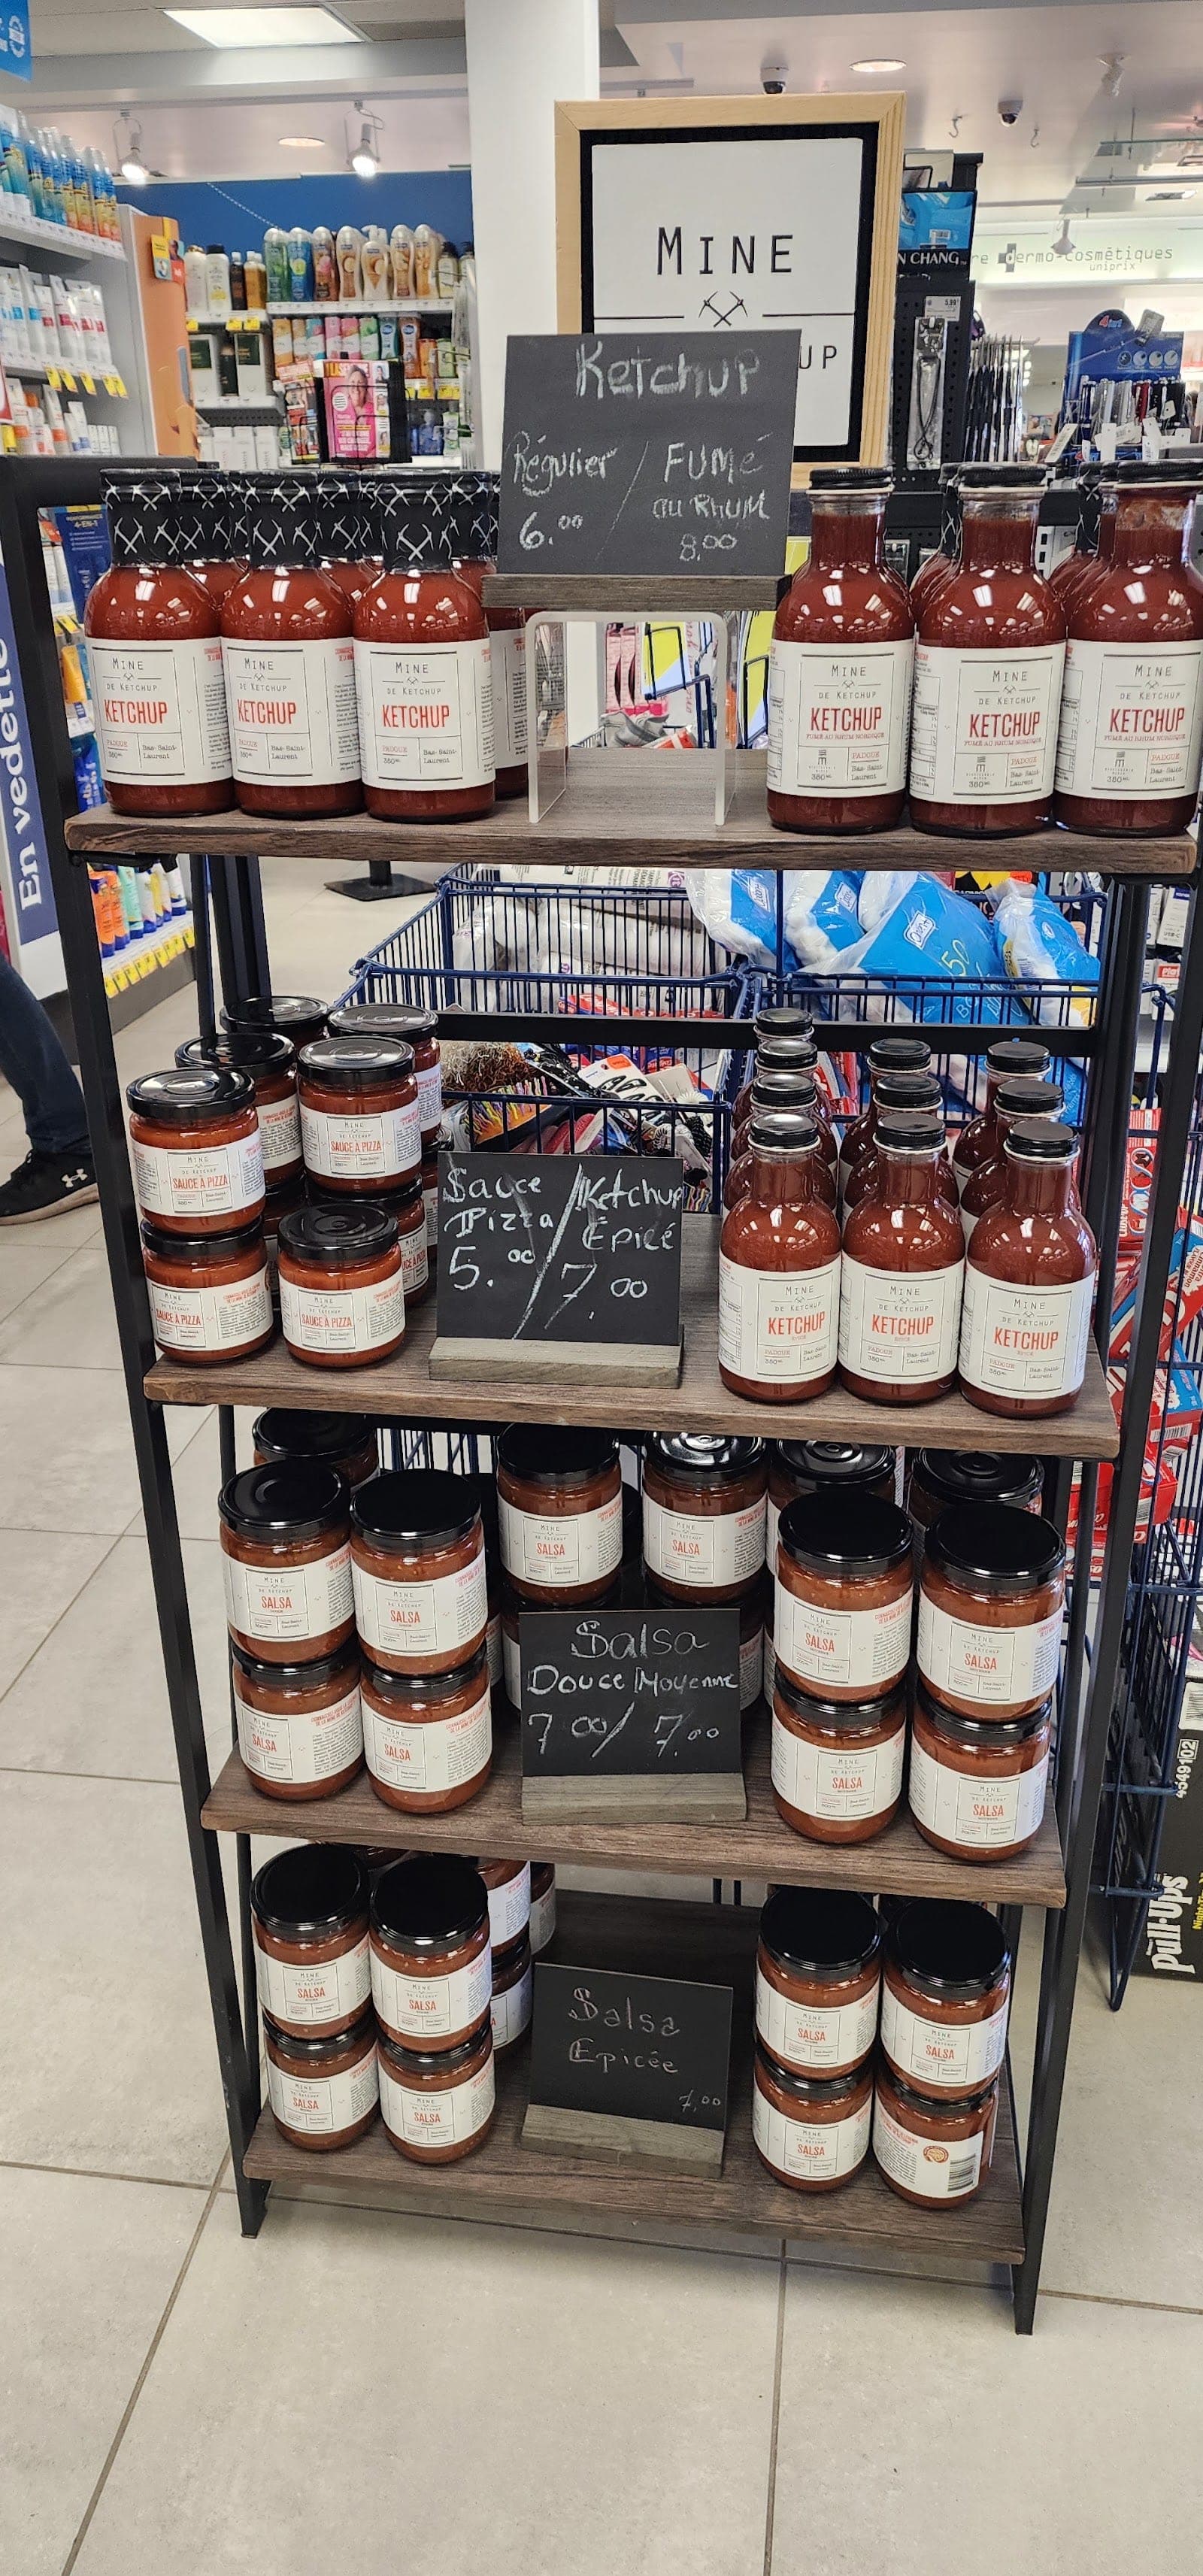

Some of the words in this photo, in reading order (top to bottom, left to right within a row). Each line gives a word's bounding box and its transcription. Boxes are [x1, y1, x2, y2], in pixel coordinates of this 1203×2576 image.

[656, 226, 794, 275] MINE
[911, 251, 960, 265] CHANG
[1089, 260, 1136, 271] uniprix
[113, 657, 144, 670] MINE
[244, 657, 274, 671] MINE
[395, 662, 429, 674] MINE
[831, 664, 867, 677] MINE
[1135, 664, 1172, 677] MINE
[992, 670, 1029, 683] MINE
[106, 683, 115, 691] DE
[120, 683, 158, 692] KETCHUP
[239, 683, 247, 691] DE
[250, 683, 287, 692] KETCHUP
[387, 687, 397, 696] DE
[402, 687, 441, 696] KETCHUP
[997, 696, 1037, 705] KETCHUP
[1120, 692, 1132, 700] DE
[1138, 691, 1180, 699] KETCHUP
[104, 699, 168, 724] KETCHUP
[237, 699, 296, 725] KETCHUP
[382, 704, 450, 729] KETCHUP
[810, 706, 882, 732] KETCHUP
[969, 711, 1041, 738] KETCHUP
[1109, 706, 1185, 733] KETCHUP
[851, 773, 877, 781] Laurent
[19, 841, 42, 911] En
[330, 1141, 353, 1153] SAUCE
[362, 1141, 382, 1151] PIZZA
[172, 1177, 198, 1190] SAUCE
[208, 1174, 229, 1187] PIZZA
[785, 1285, 814, 1296] MINE
[889, 1286, 921, 1297] MINE
[789, 1302, 822, 1311] KETCHUP
[1014, 1298, 1047, 1310] MINE
[155, 1309, 174, 1324] SAUCE
[181, 1313, 202, 1326] PIZZA
[301, 1314, 323, 1328] SAUCE
[331, 1316, 353, 1328] PIZZA
[768, 1311, 826, 1336] KETCHUP
[1001, 1316, 1013, 1324] DE
[1017, 1318, 1055, 1326] KETCHUP
[871, 1314, 935, 1336] KETCHUP
[994, 1326, 1059, 1350] KETCHUP
[537, 1542, 565, 1556] SALSA
[672, 1539, 700, 1556] SALSA
[261, 1596, 292, 1609] SALSA
[390, 1610, 421, 1623] SALSA
[810, 1614, 831, 1626] MINE
[570, 1620, 711, 1660] Salsa
[805, 1632, 835, 1653] SALSA
[971, 1633, 994, 1644] MINE
[964, 1653, 997, 1670] SALSA
[526, 1663, 626, 1695] Douce
[252, 1733, 277, 1753] SALSA
[384, 1744, 411, 1762] SALSA
[832, 1776, 863, 1790] SALSA
[979, 1785, 1001, 1793] MINE
[973, 1804, 1005, 1817] SALSA
[297, 1986, 326, 1999] SALSA
[408, 1999, 437, 2011] SALSA
[568, 1987, 680, 2037] Salsa
[797, 2027, 826, 2042] SALSA
[926, 2044, 955, 2060] SALSA
[292, 2096, 320, 2111] SALSA
[414, 2111, 441, 2123] SALSA
[797, 2144, 826, 2156] SALSA
